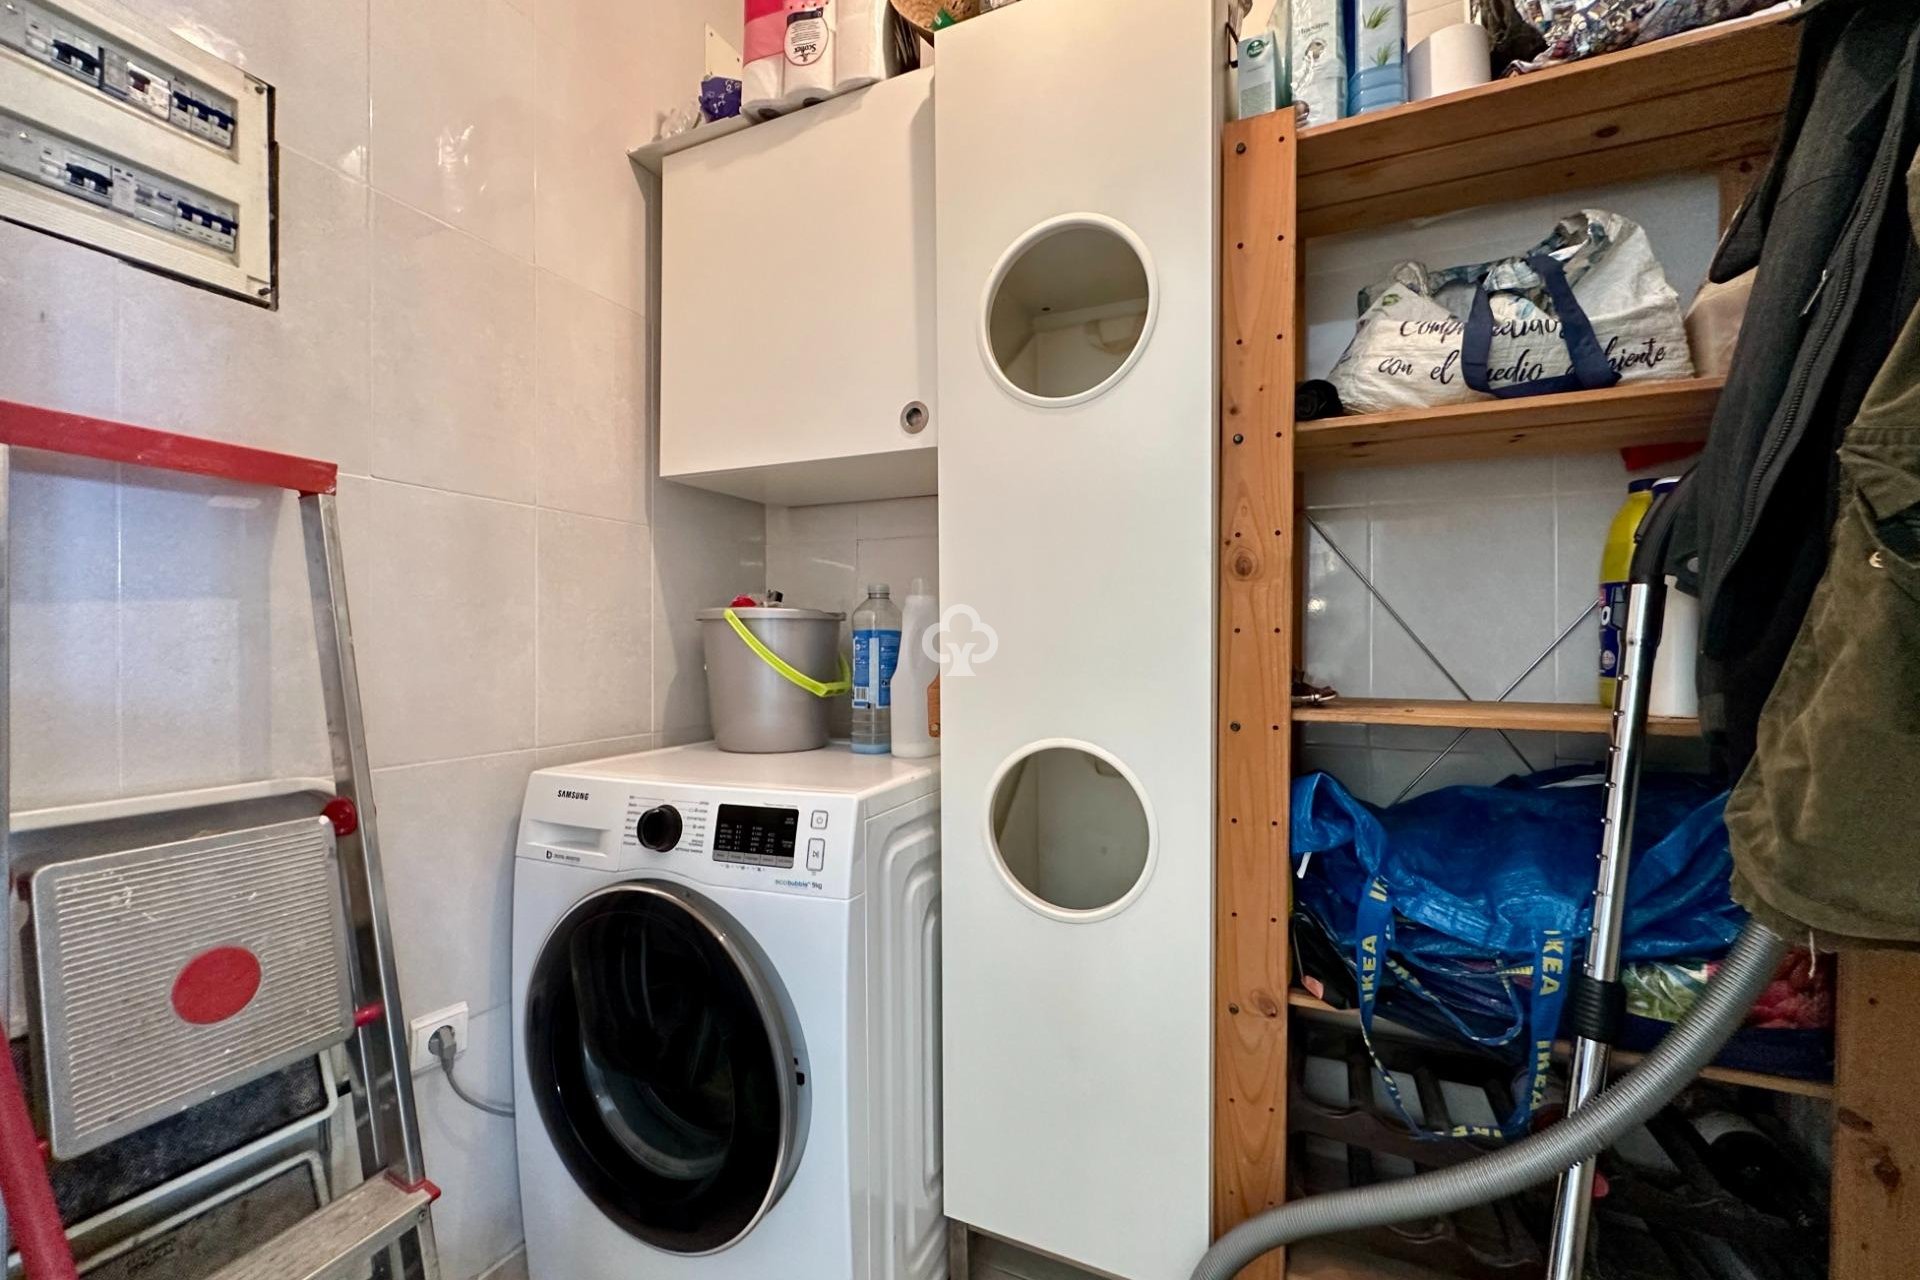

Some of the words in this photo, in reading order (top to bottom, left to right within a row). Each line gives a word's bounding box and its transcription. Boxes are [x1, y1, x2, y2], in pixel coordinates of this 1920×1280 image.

[1378, 357, 1413, 376] con
[1430, 350, 1460, 385] el
[557, 789, 590, 801] SAMSUNG
[1361, 935, 1378, 1002] IKEA
[1539, 930, 1565, 996] IKEA
[1529, 1040, 1551, 1111] IKEA
